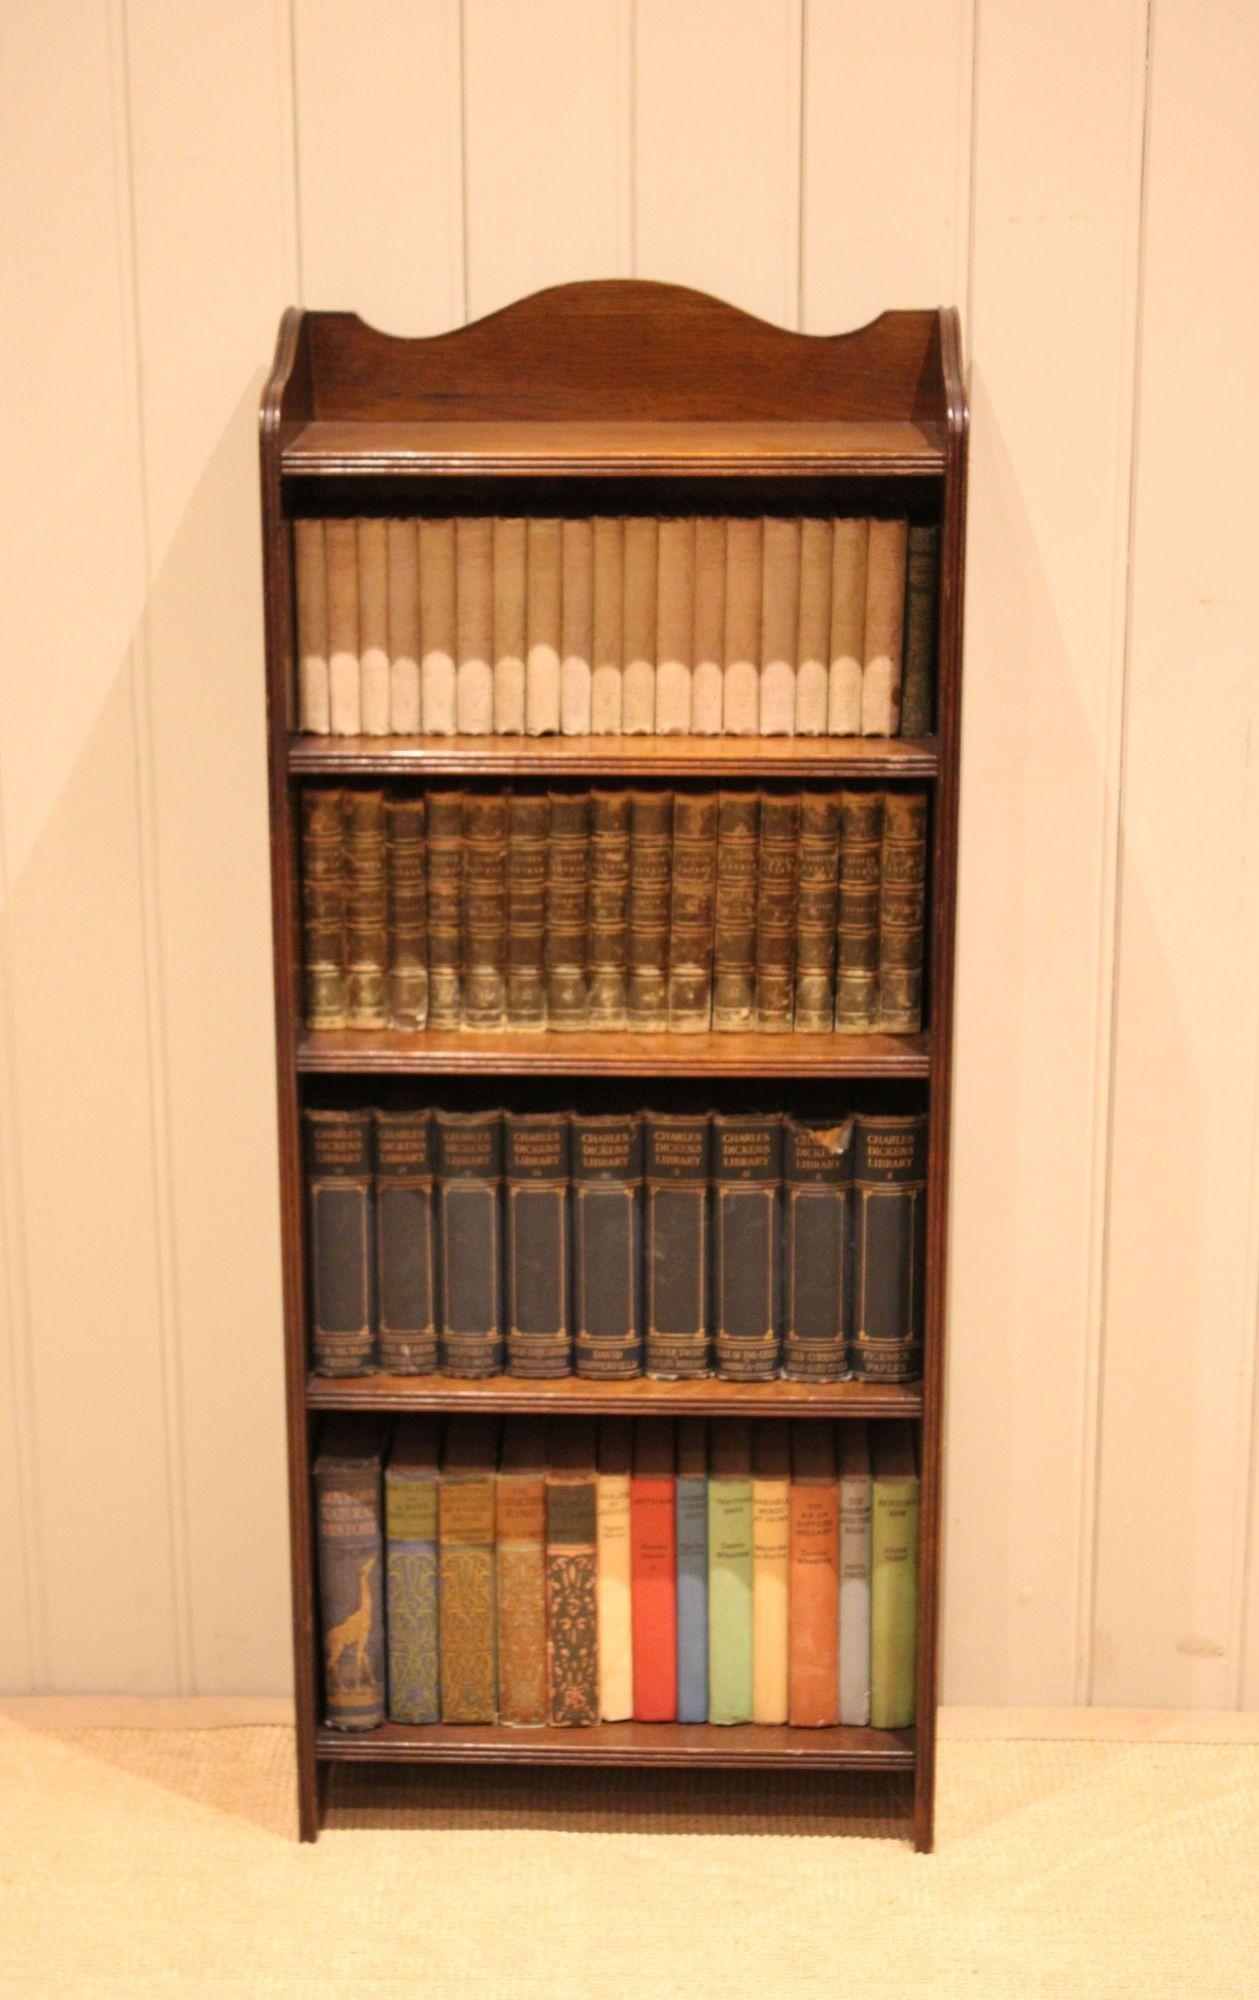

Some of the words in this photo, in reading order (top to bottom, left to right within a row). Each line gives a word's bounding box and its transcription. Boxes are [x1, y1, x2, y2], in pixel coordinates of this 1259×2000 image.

[581, 1133, 630, 1143] CHARLES
[654, 1131, 702, 1142] CHARLES
[722, 1133, 770, 1143] CHARLES
[867, 1135, 914, 1145] CHARLES
[582, 1145, 630, 1155] DICKENS
[655, 1143, 702, 1154] DICKENS
[724, 1145, 770, 1155] DICKENS
[868, 1146, 914, 1156] DICKENS
[582, 1157, 628, 1167] LIBRARY
[655, 1155, 701, 1166] LIBRARY
[724, 1157, 769, 1167] LIBRARY
[796, 1159, 840, 1169] LIBRARY
[868, 1158, 913, 1168] LIBRARY
